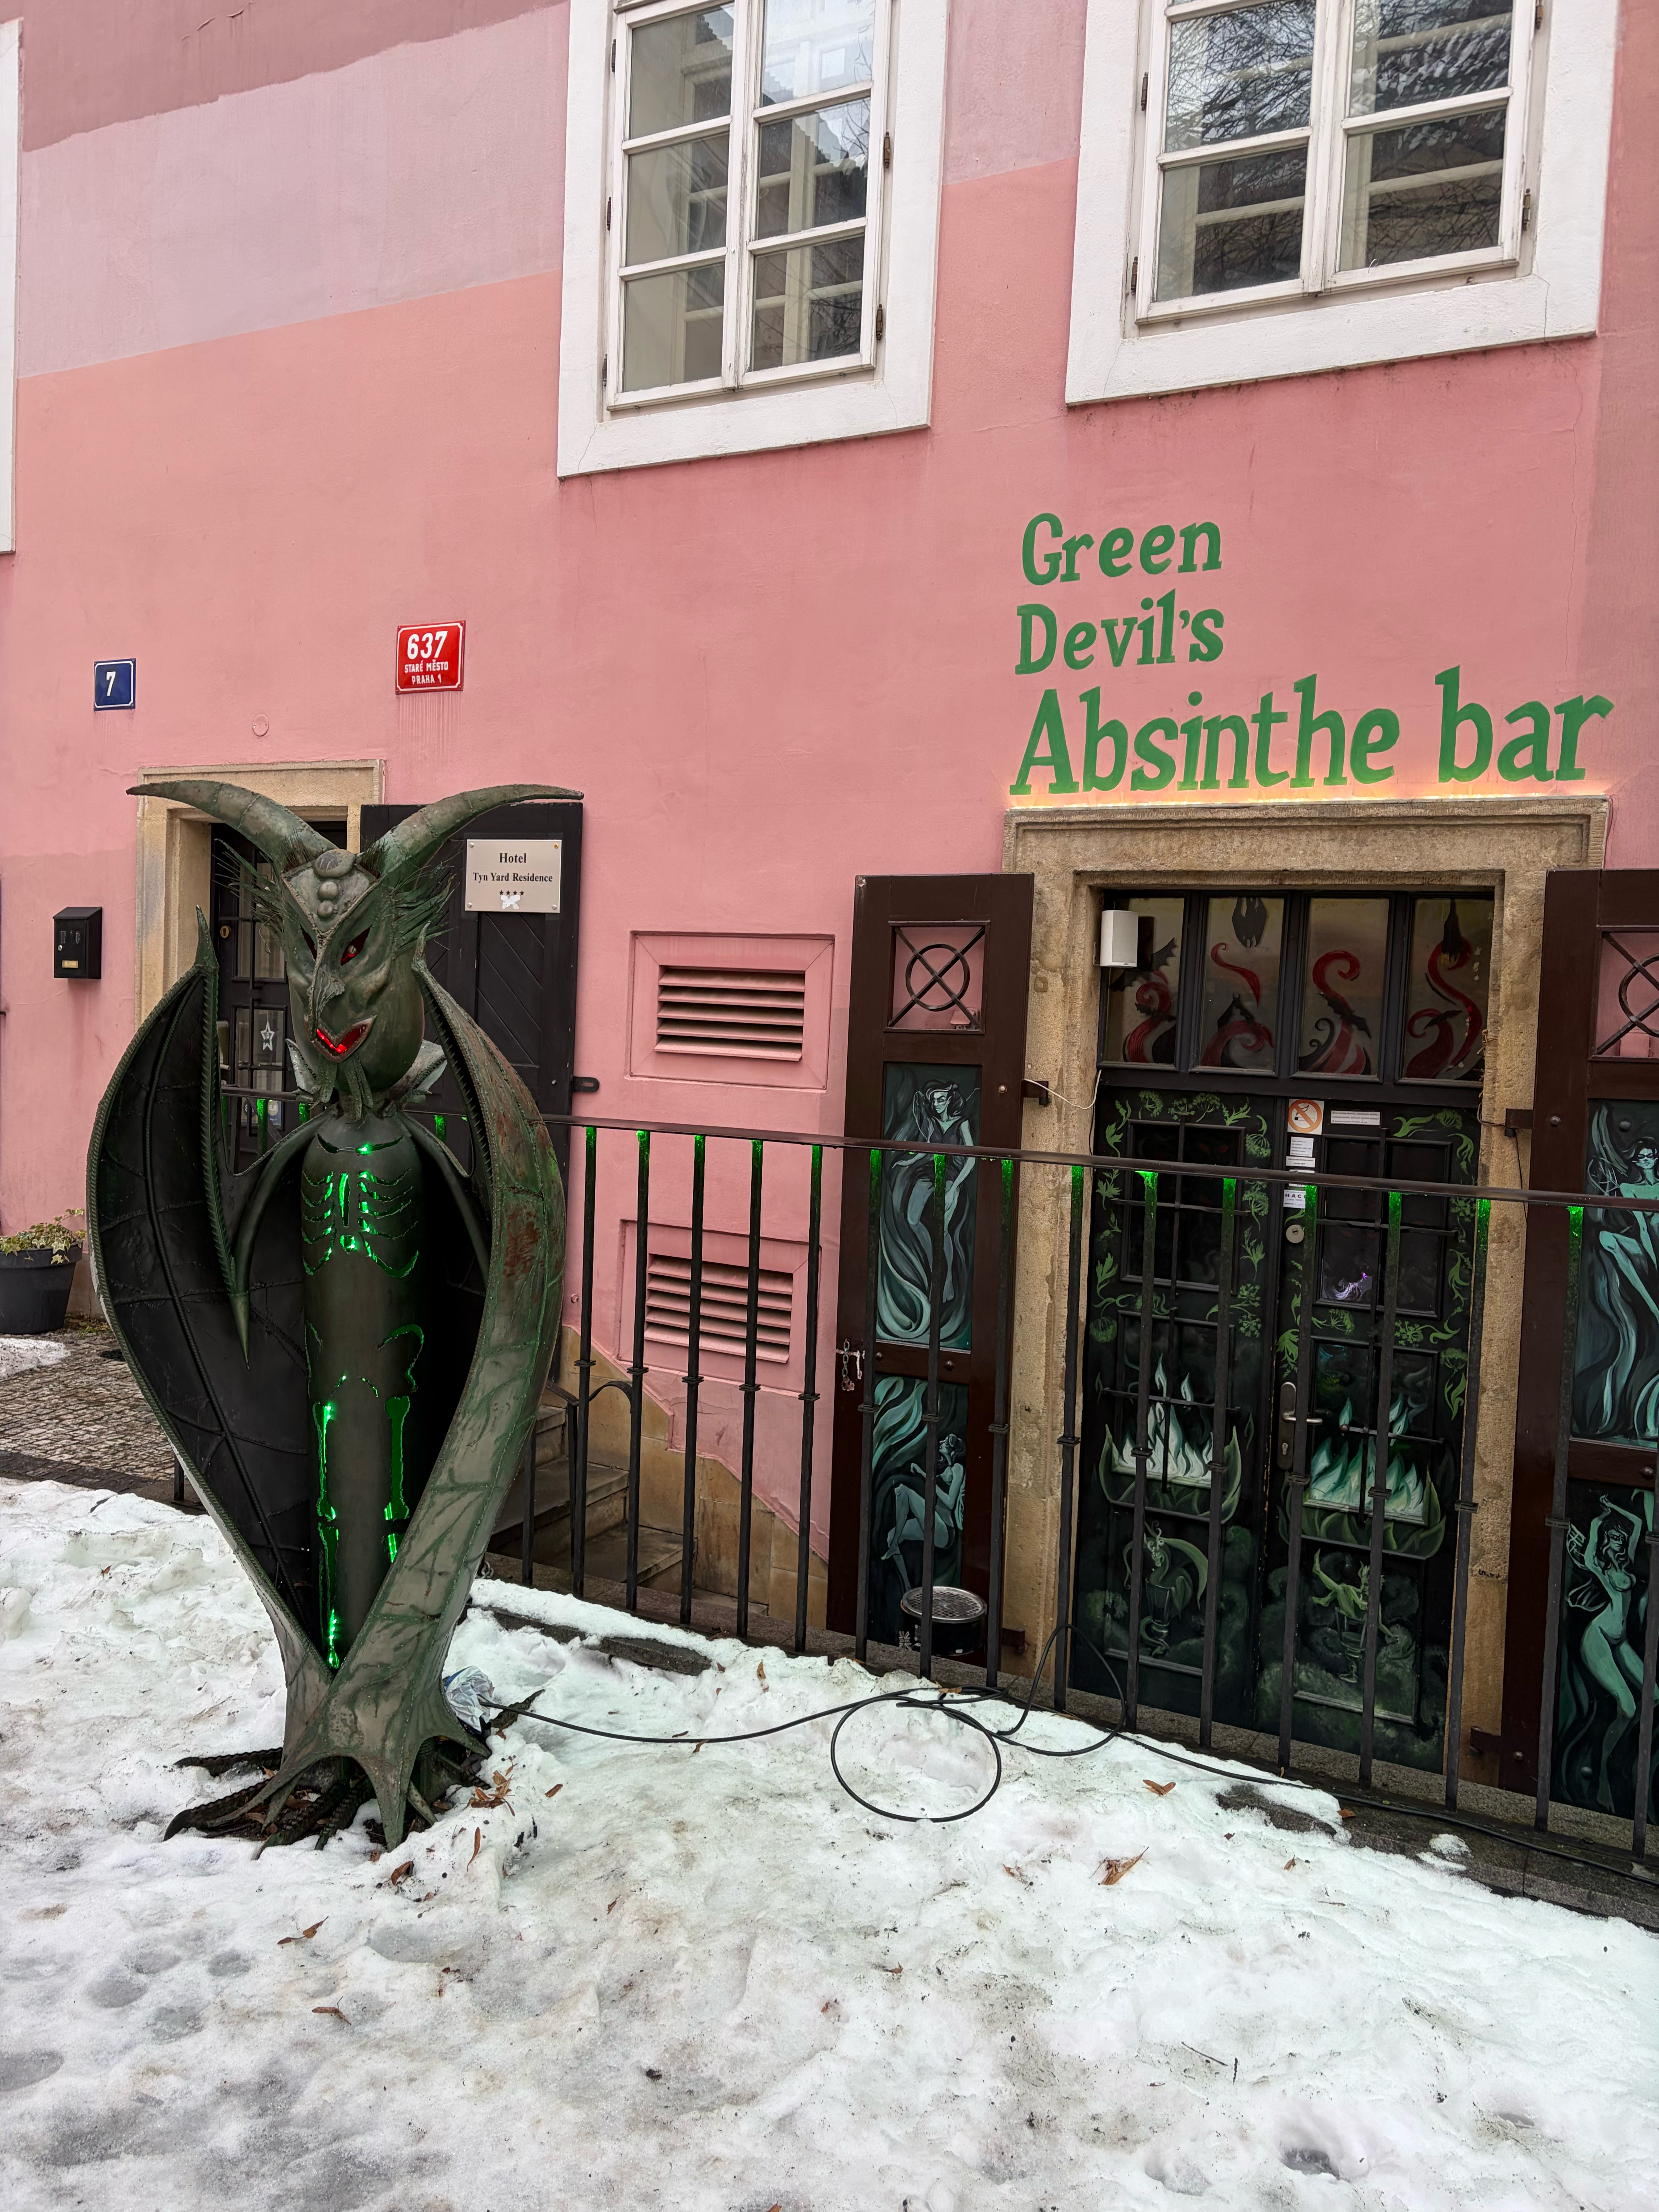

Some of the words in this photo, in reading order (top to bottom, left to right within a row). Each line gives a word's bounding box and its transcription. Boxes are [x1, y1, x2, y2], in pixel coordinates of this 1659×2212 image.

[1023, 514, 1221, 585] Green
[1015, 589, 1224, 674] Devil's
[407, 631, 448, 659] 637
[404, 660, 423, 673] STARÉ
[426, 659, 448, 672] MĚSTO
[106, 671, 116, 696] 7
[412, 675, 435, 685] PRAHA
[438, 674, 441, 683] 1
[1010, 674, 1399, 794] Absinthe
[1435, 665, 1614, 782] bar
[499, 853, 526, 863] Hotel
[472, 872, 488, 883] Tyn
[490, 872, 509, 881] Yard
[512, 872, 553, 882] Residence
